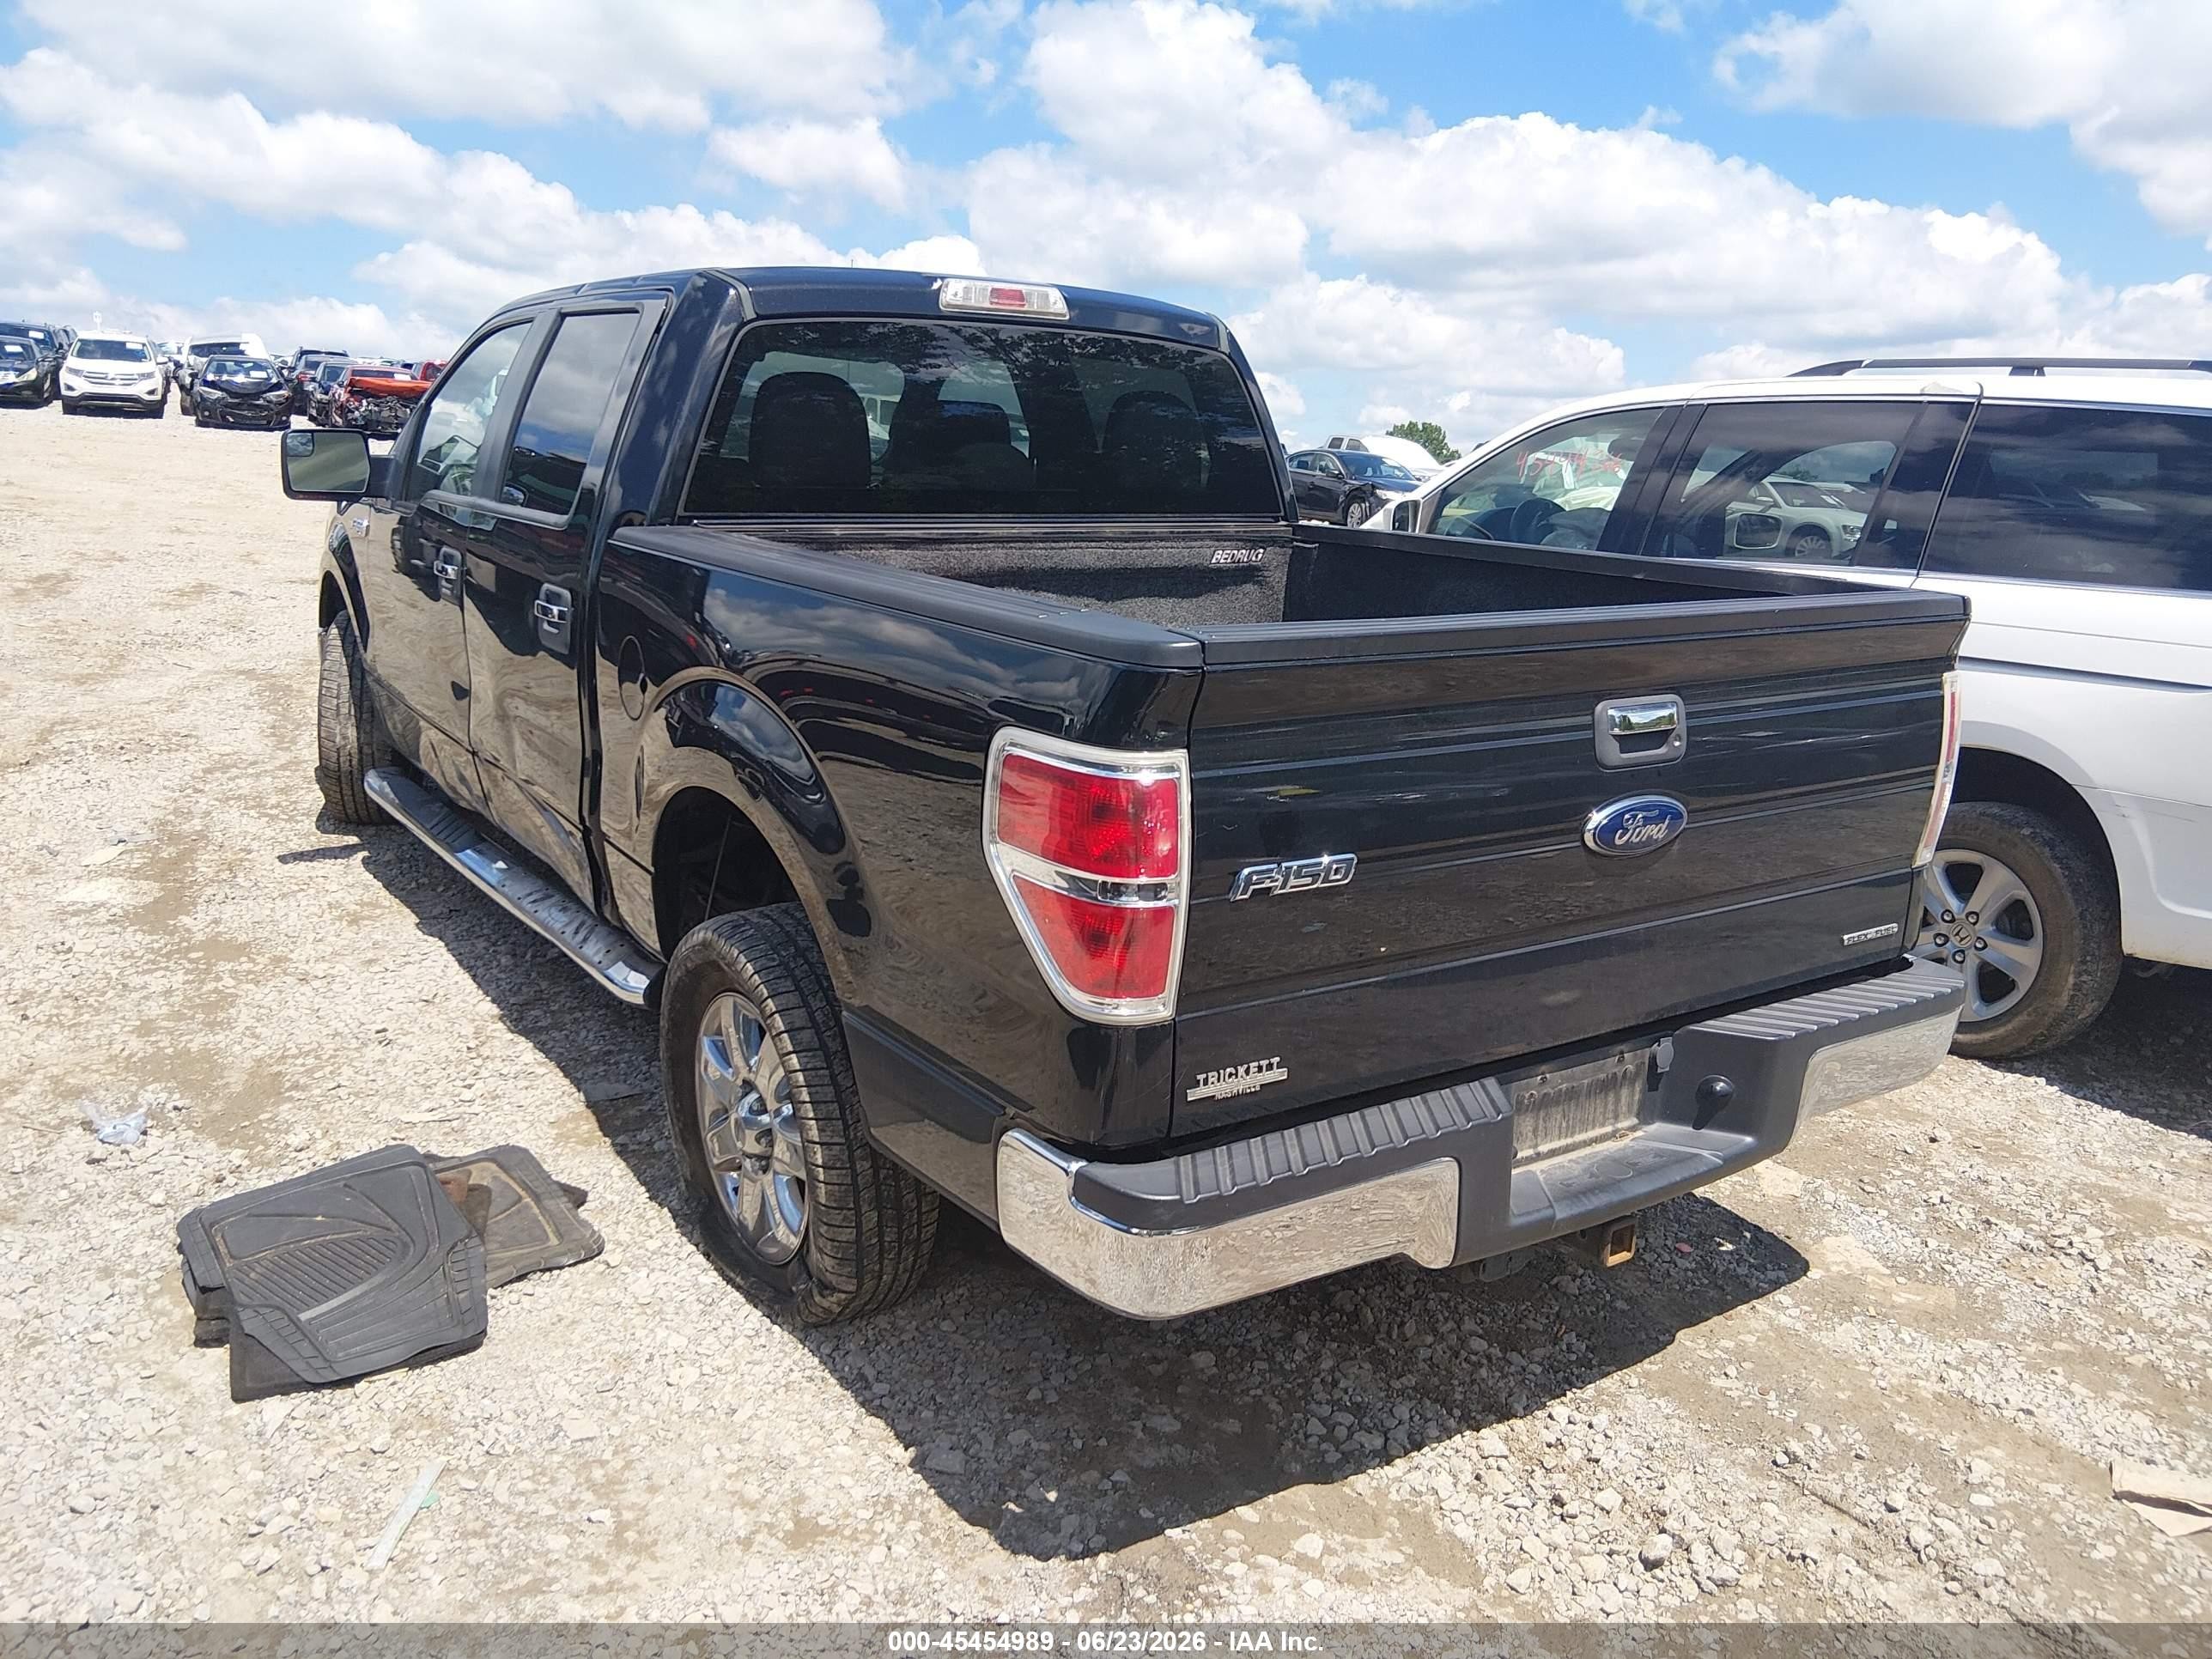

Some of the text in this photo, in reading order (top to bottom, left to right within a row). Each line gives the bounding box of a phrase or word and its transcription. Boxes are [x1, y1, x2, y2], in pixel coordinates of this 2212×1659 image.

[1211, 548, 1265, 564] BEDRUG
[1614, 809, 1672, 846] Ford
[1230, 853, 1358, 902] F-150
[1196, 1056, 1281, 1089] TRICKETT
